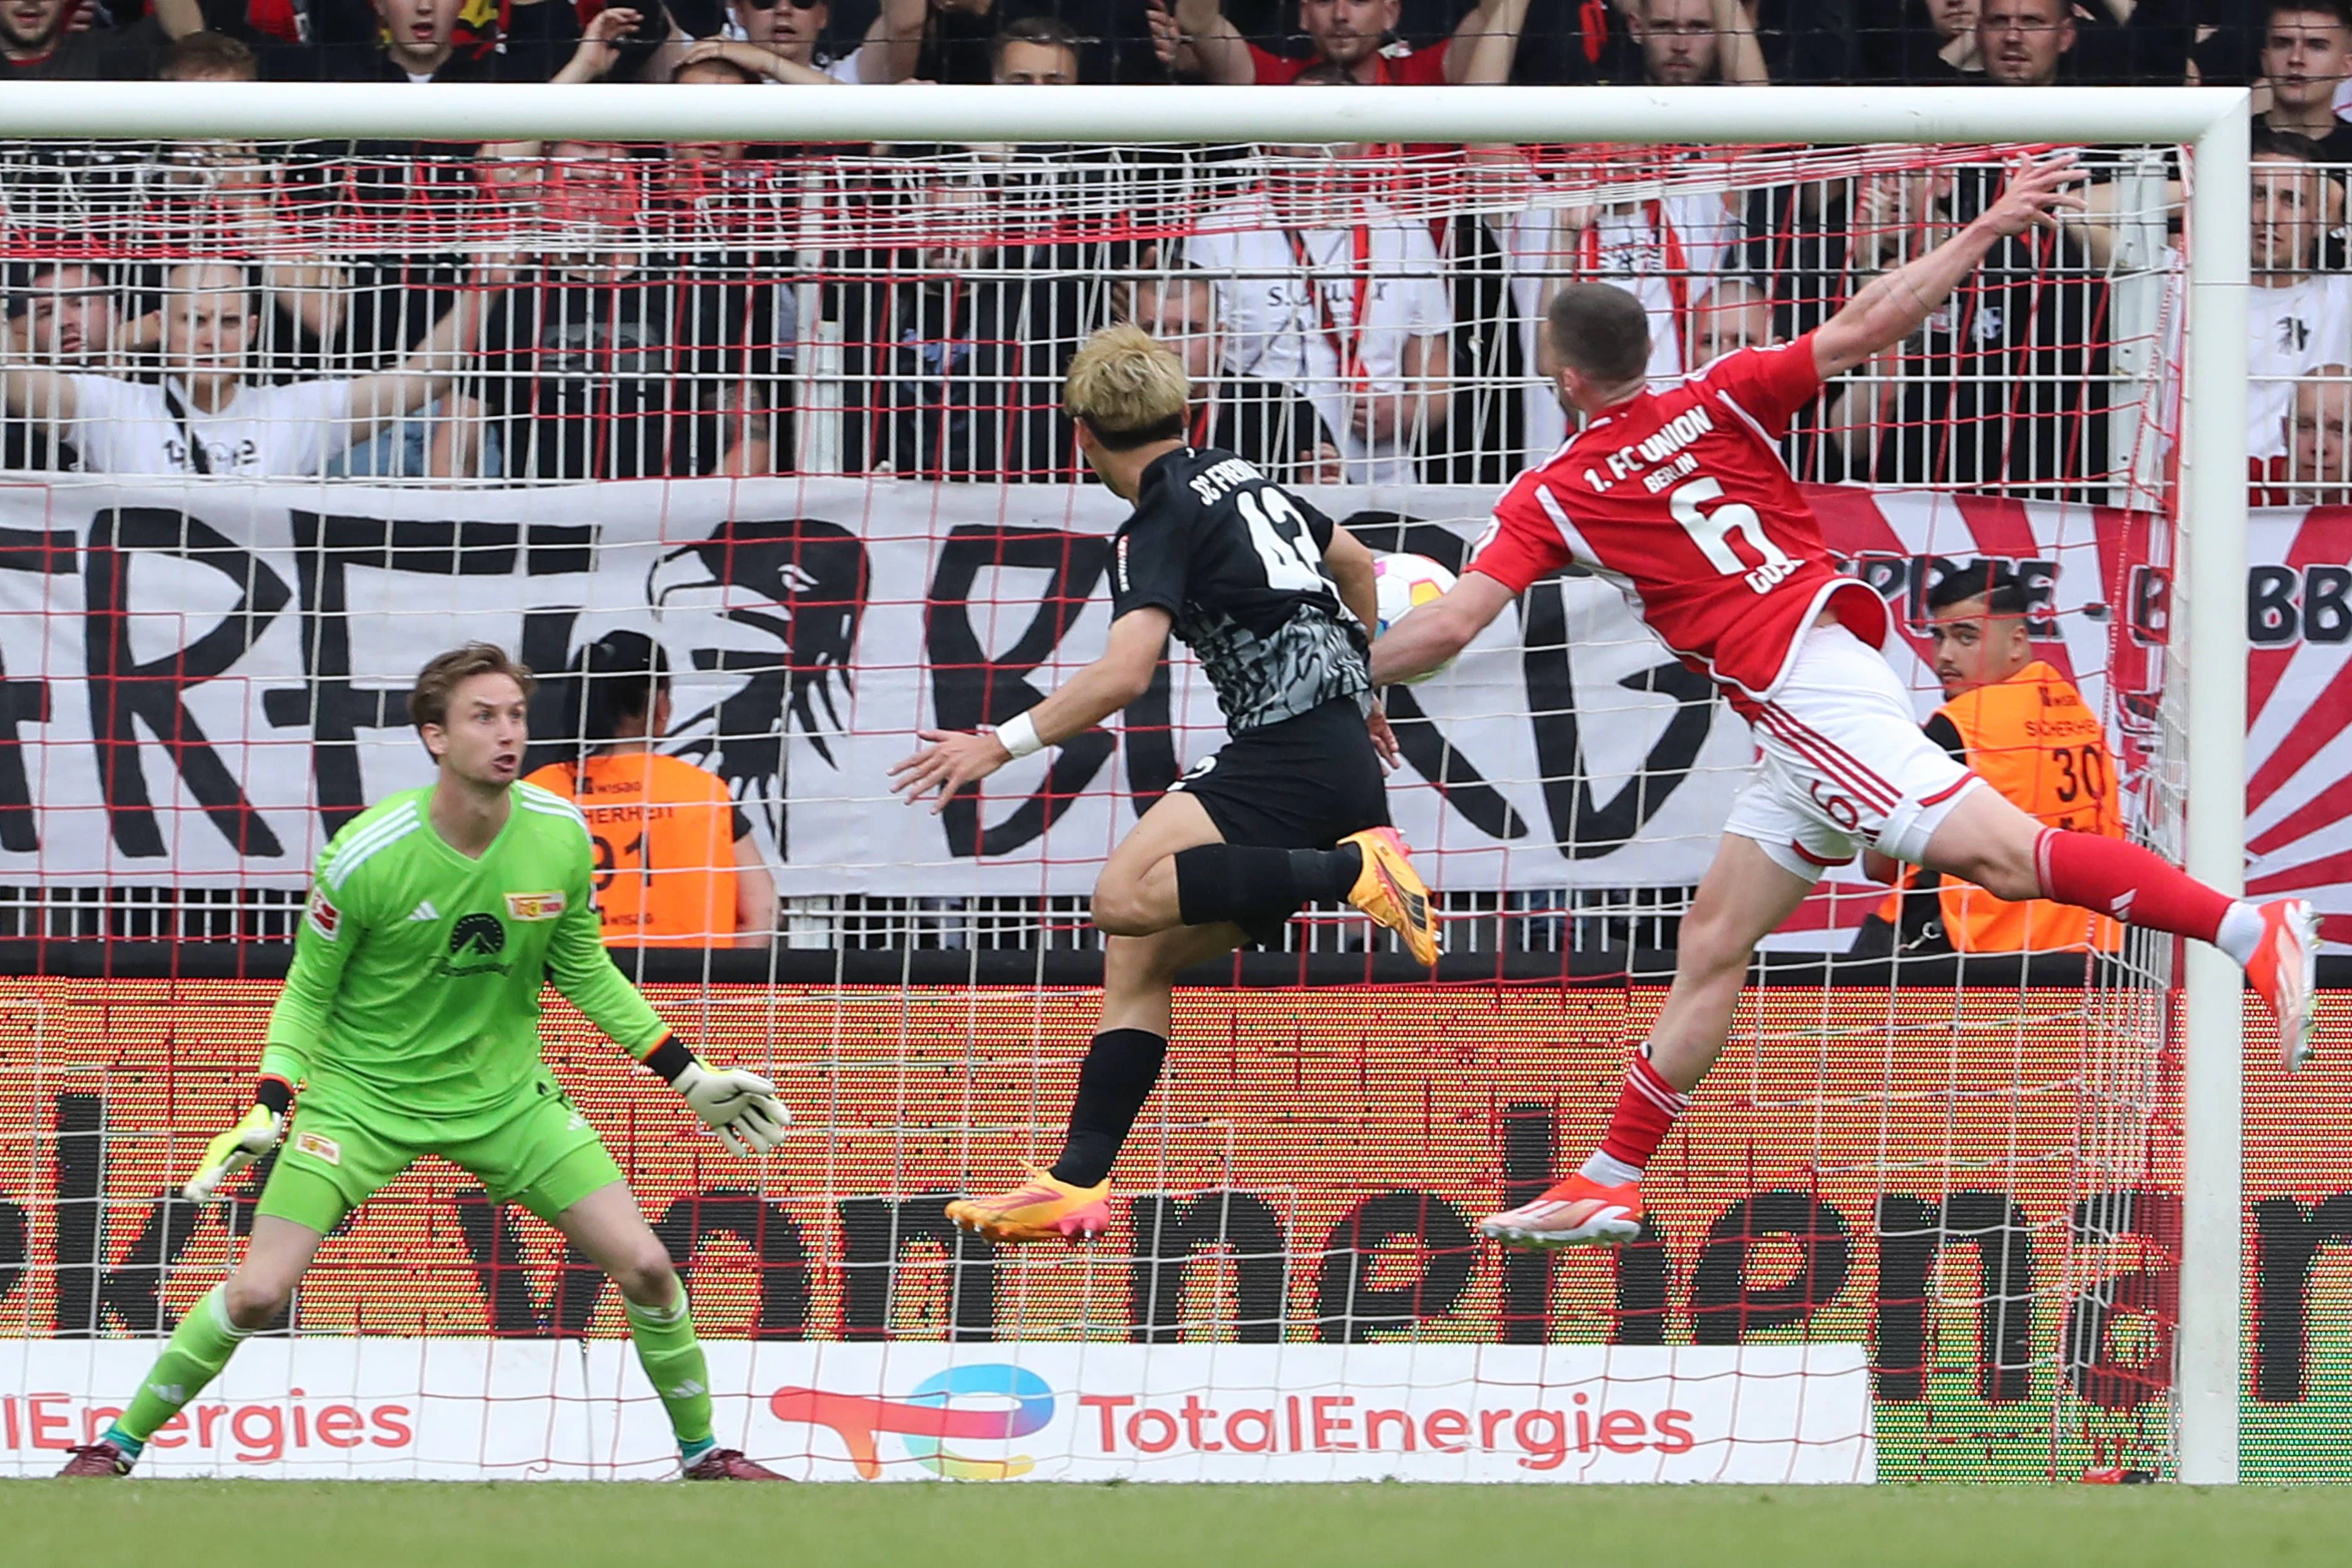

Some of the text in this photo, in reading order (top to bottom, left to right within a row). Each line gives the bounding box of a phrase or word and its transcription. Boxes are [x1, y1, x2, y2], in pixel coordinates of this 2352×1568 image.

[1583, 405, 1715, 493] 1. FC UNION
[1642, 452, 1700, 494] BERLIN
[1189, 474, 1223, 506] SC
[1236, 486, 1344, 604] 42
[1669, 476, 1789, 576] 6
[1810, 779, 1859, 831] 6
[2052, 743, 2106, 803] 30
[1078, 1391, 1695, 1471] TotalEnergies
